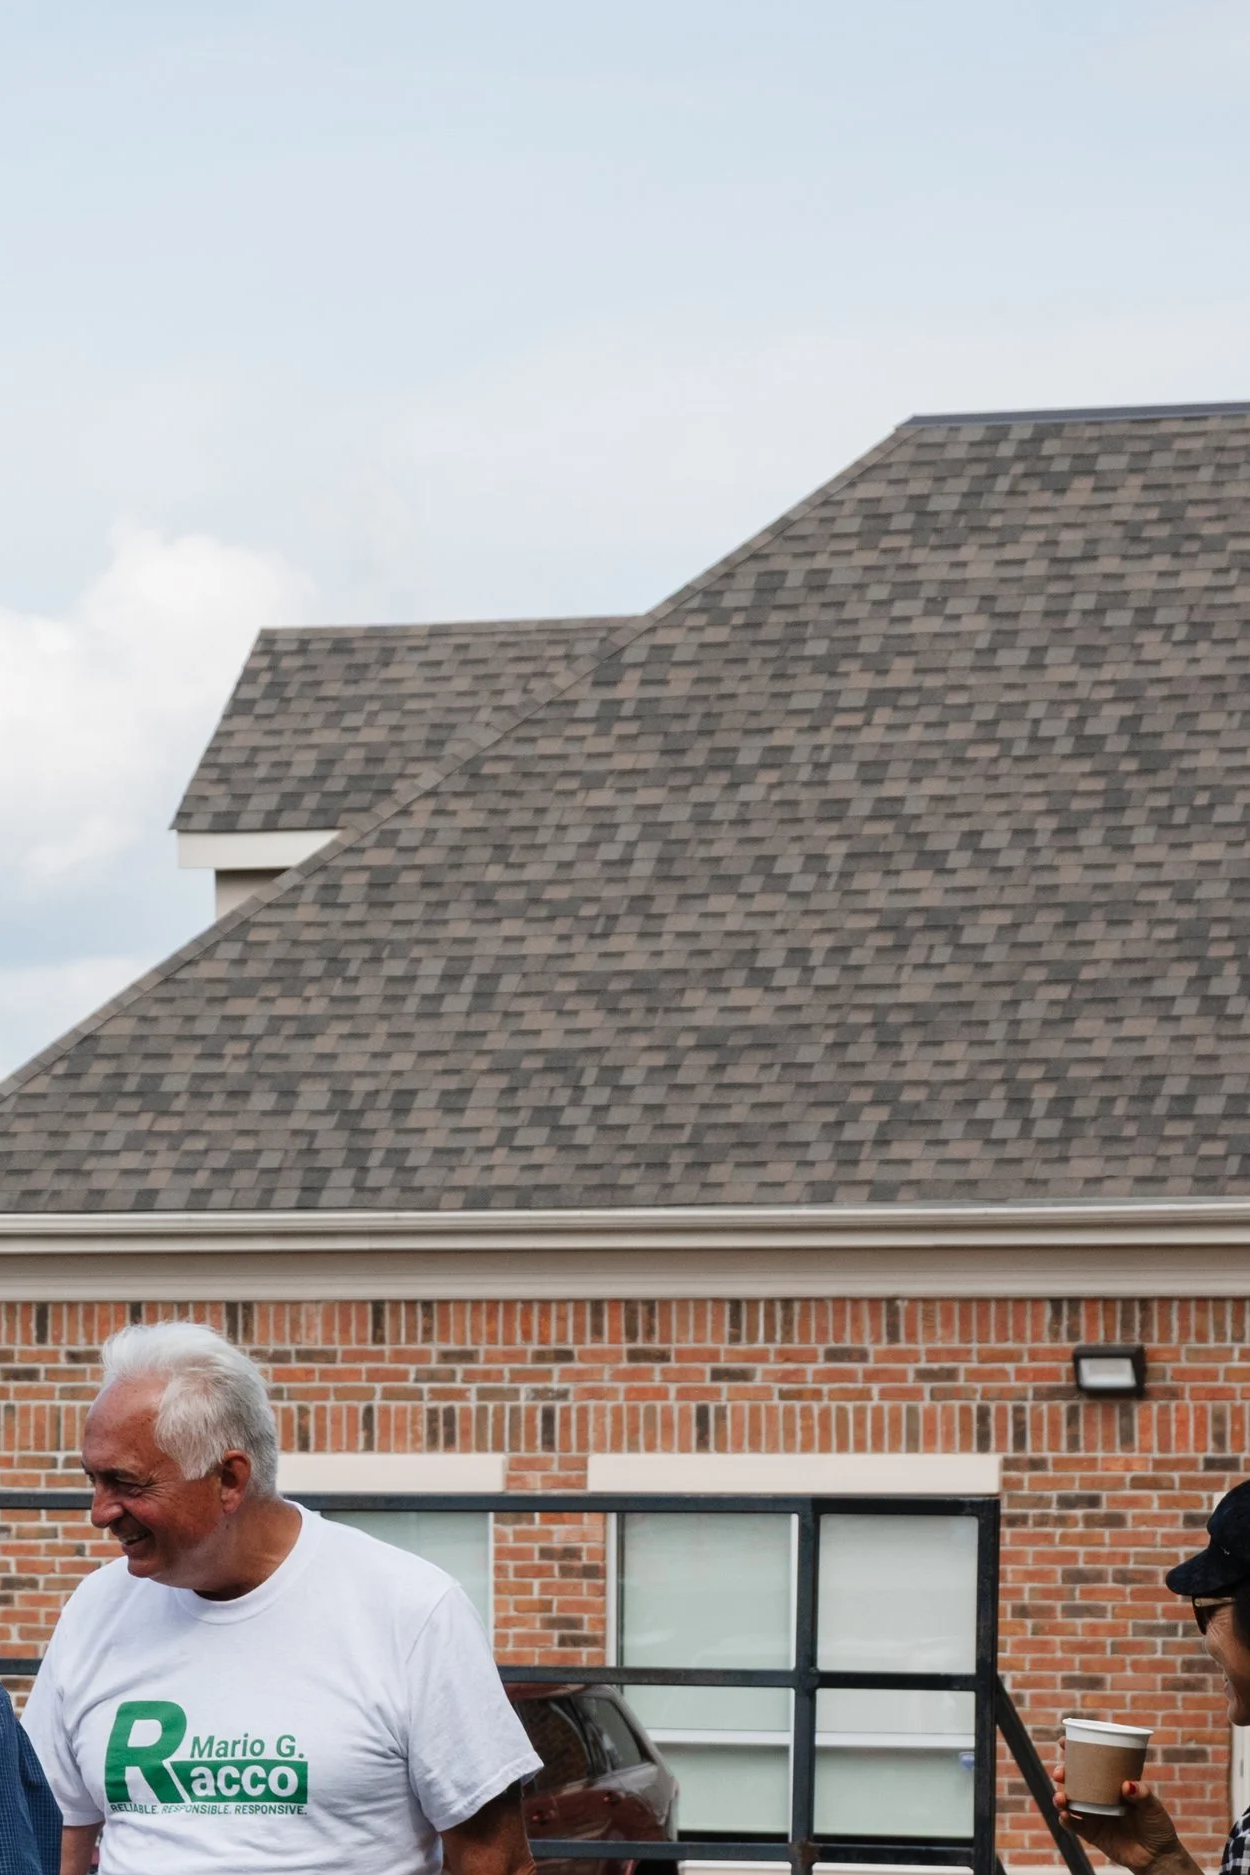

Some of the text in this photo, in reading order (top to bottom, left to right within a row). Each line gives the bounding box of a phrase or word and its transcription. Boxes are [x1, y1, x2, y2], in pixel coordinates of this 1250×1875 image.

[105, 1700, 300, 1804] Racco
[190, 1733, 305, 1759] Mario G.
[234, 1804, 308, 1815] RESPONSIVE.
